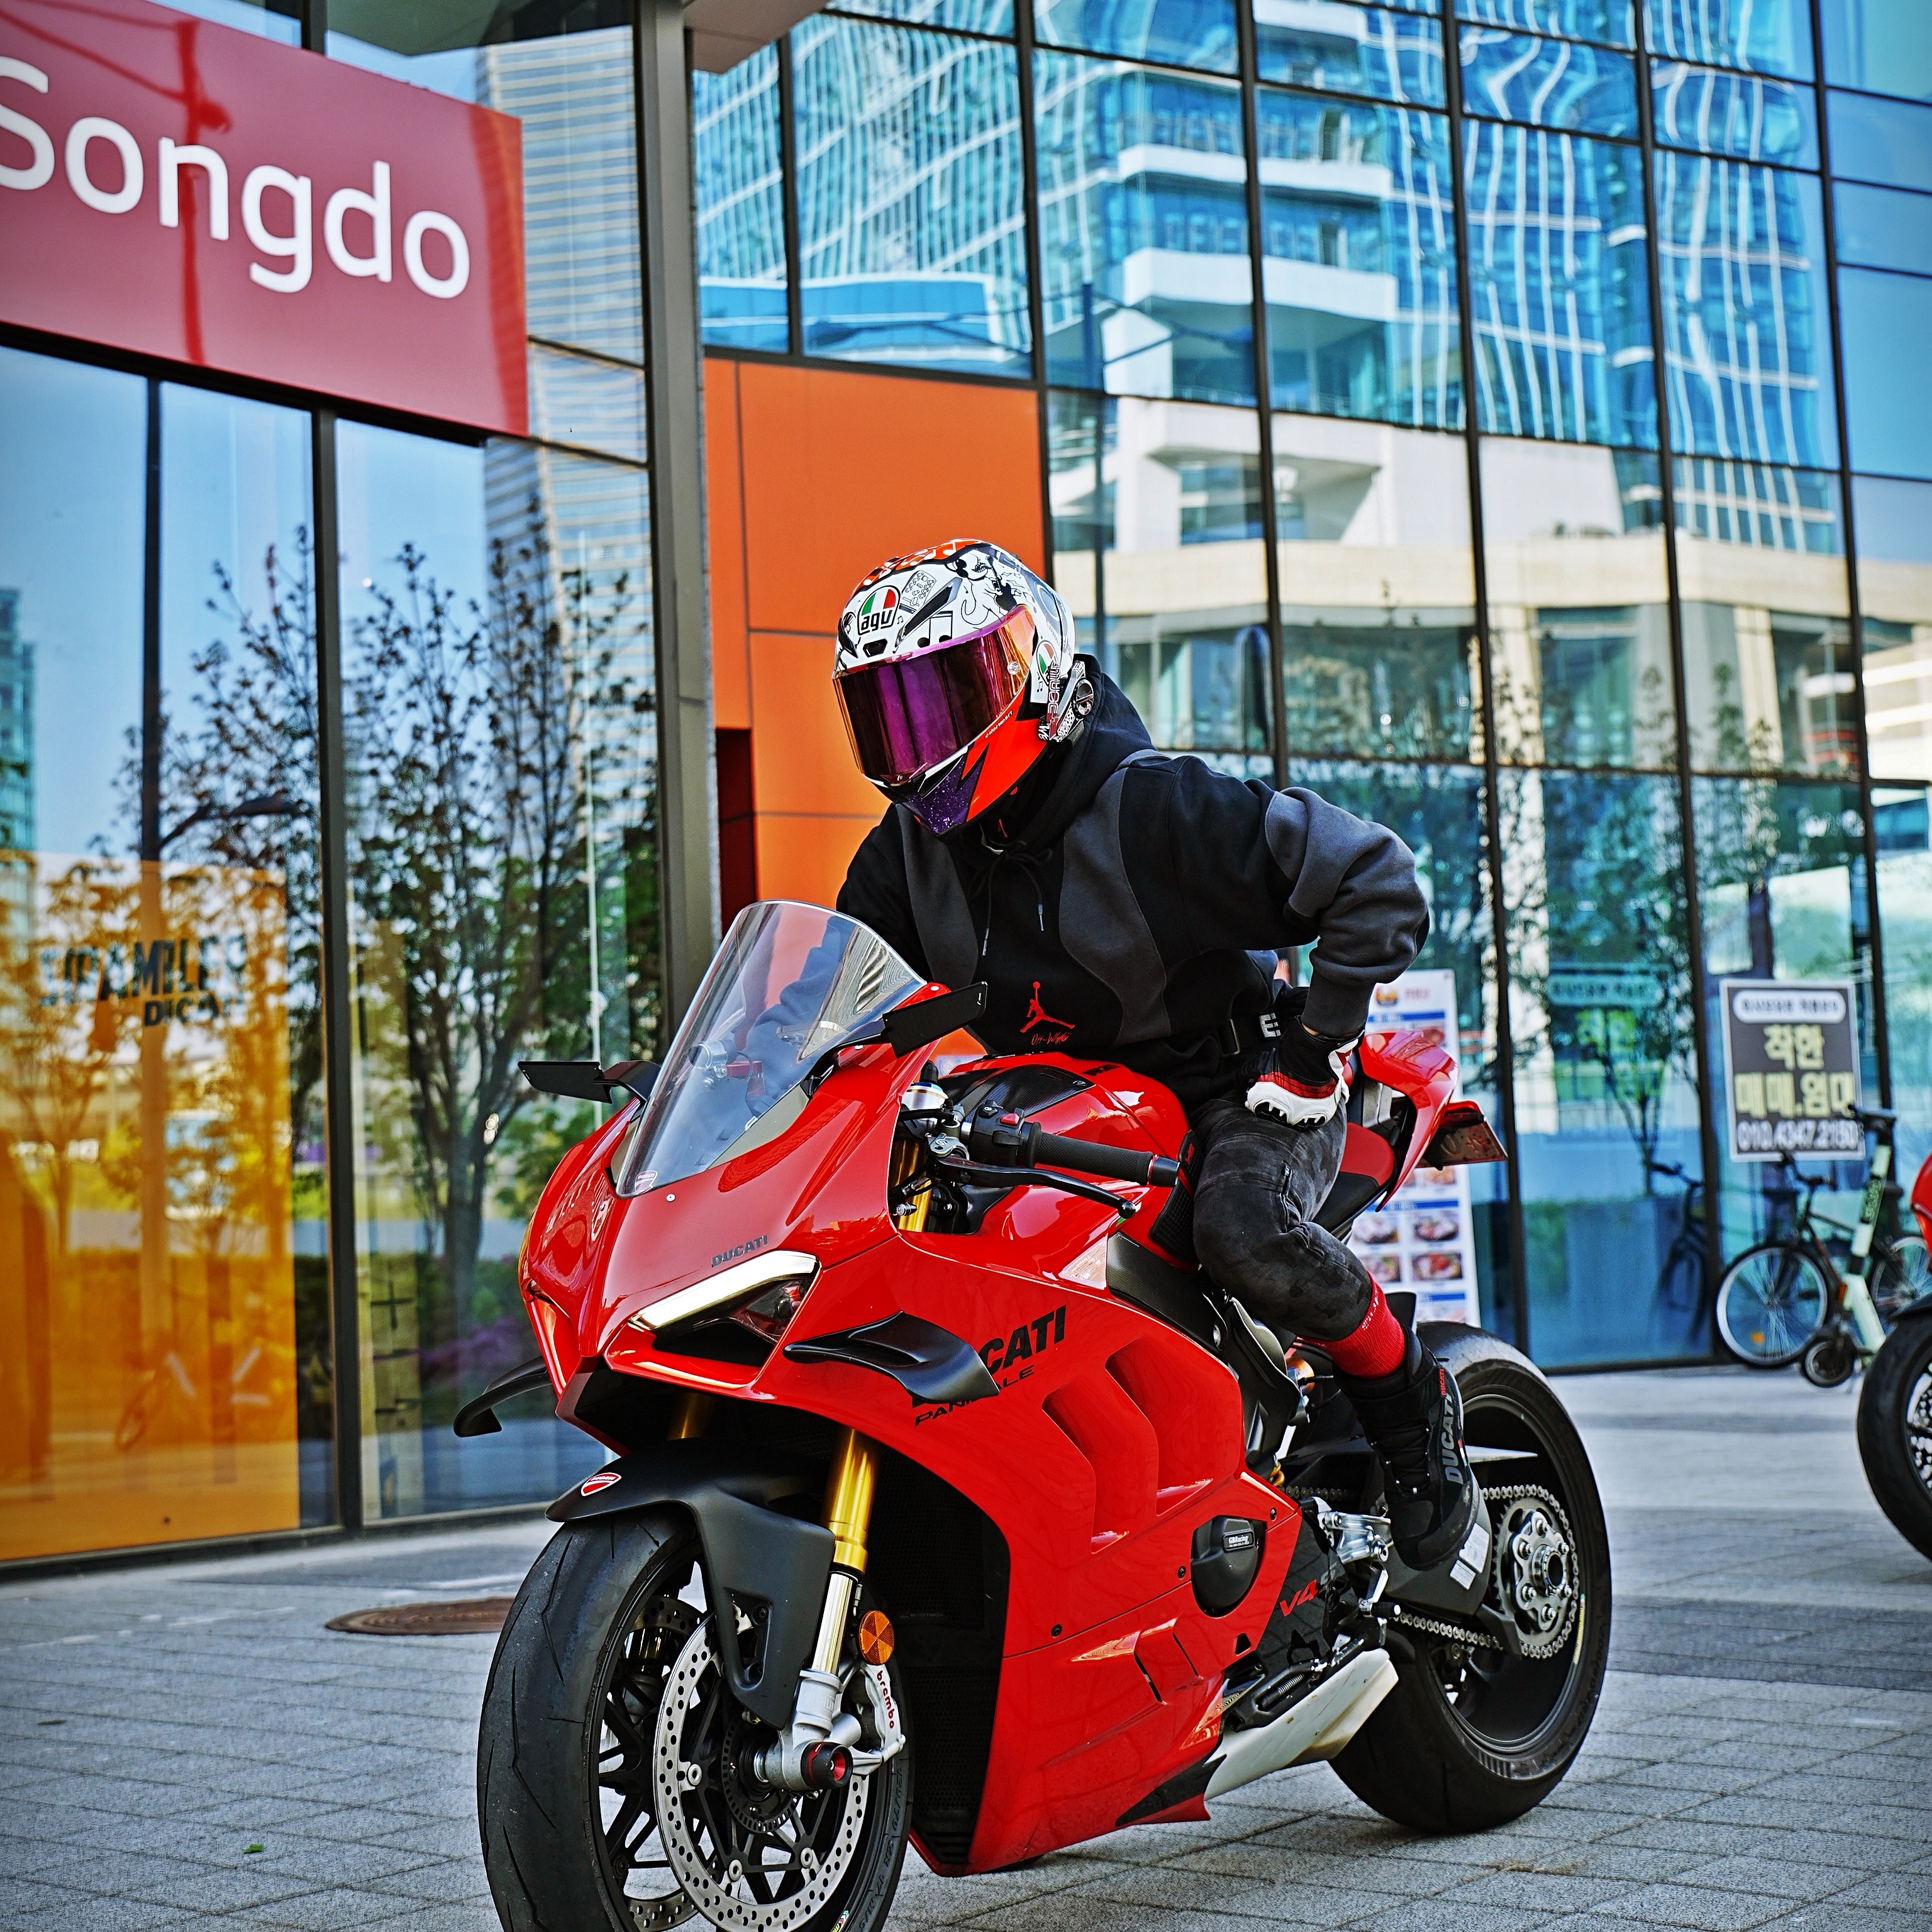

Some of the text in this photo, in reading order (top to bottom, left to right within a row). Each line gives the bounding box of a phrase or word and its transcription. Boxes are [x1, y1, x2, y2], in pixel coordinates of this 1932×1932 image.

[0, 56, 470, 299] Songdo
[711, 1235, 768, 1268] DUCATI
[1441, 1392, 1464, 1484] DUCATI
